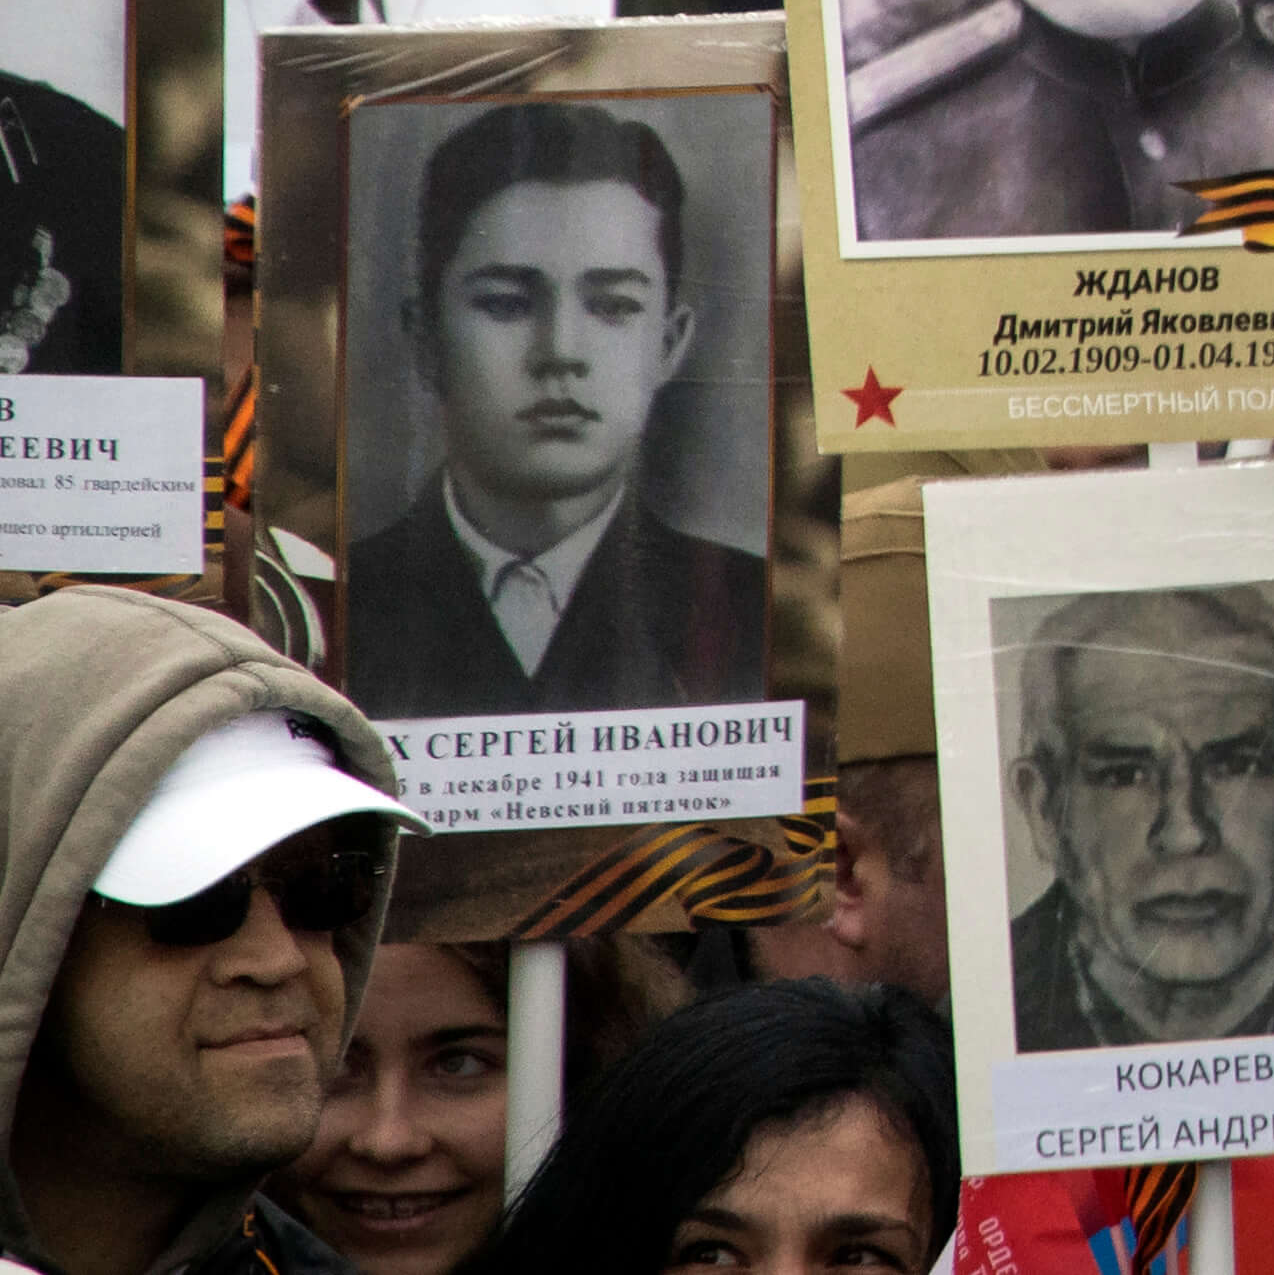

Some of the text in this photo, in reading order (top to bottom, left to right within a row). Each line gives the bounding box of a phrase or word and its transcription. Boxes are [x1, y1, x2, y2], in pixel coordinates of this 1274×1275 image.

[1074, 266, 1219, 300] ЖДАНОВ
[992, 310, 1133, 345] Дмитрий
[1007, 385, 1219, 420] БЕССМЕРТНЫЙ
[55, 474, 74, 490] 85
[82, 478, 196, 495] гвардейским
[51, 523, 162, 542] артиллерией
[427, 722, 577, 760] СЕРГЕЙ
[592, 715, 792, 753] ИВАНОВИЧ
[420, 782, 431, 795] в
[442, 774, 542, 797] декабре
[553, 770, 605, 791] 1941
[616, 770, 666, 790] года
[677, 764, 781, 787] защищая
[490, 797, 610, 823] «Невский
[622, 796, 731, 817] пятачок»
[1115, 1053, 1274, 1093] КОКАРЕВ
[1036, 1116, 1162, 1159] СЕРГЕЙ
